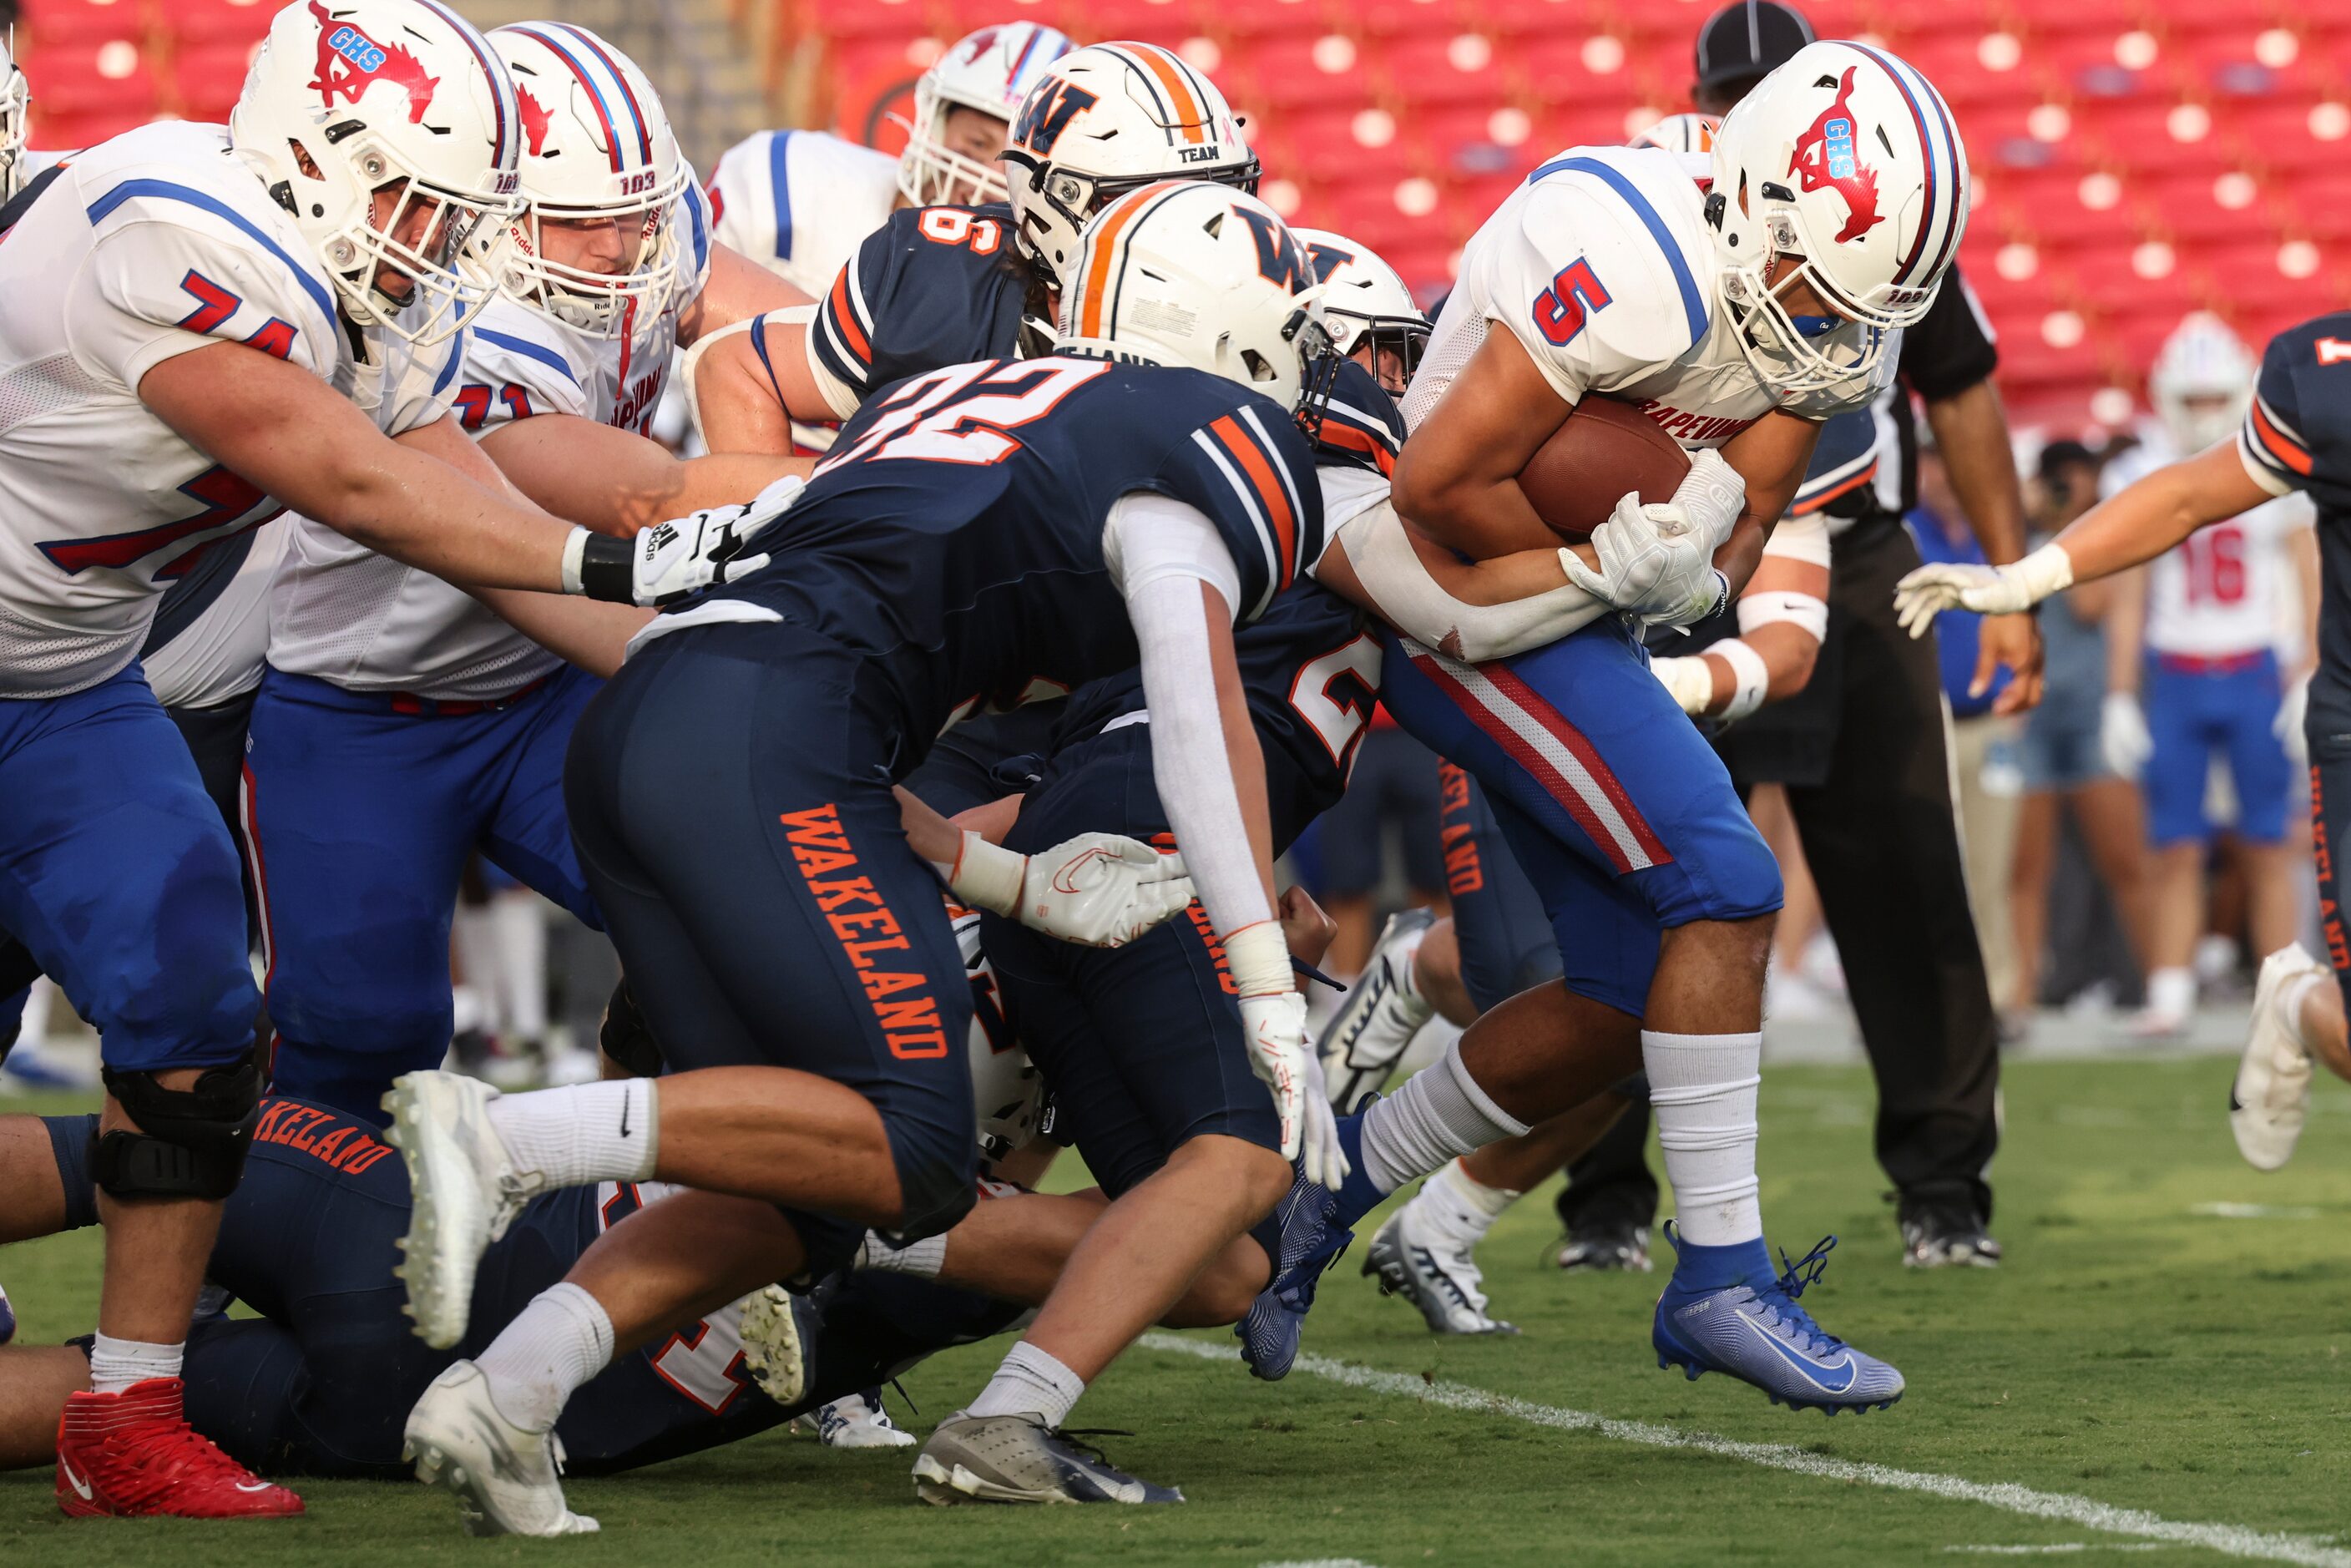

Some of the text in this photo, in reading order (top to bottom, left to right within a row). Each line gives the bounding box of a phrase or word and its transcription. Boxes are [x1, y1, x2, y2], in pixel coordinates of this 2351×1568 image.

[328, 27, 386, 73] GHS
[1013, 73, 1100, 158] W
[1824, 117, 1856, 179] GHS
[619, 170, 656, 195] 103
[1178, 145, 1220, 164] TEAM
[1532, 255, 1613, 347] 5
[780, 803, 948, 1060] WAKELAND
[253, 1099, 394, 1175] KELAND
